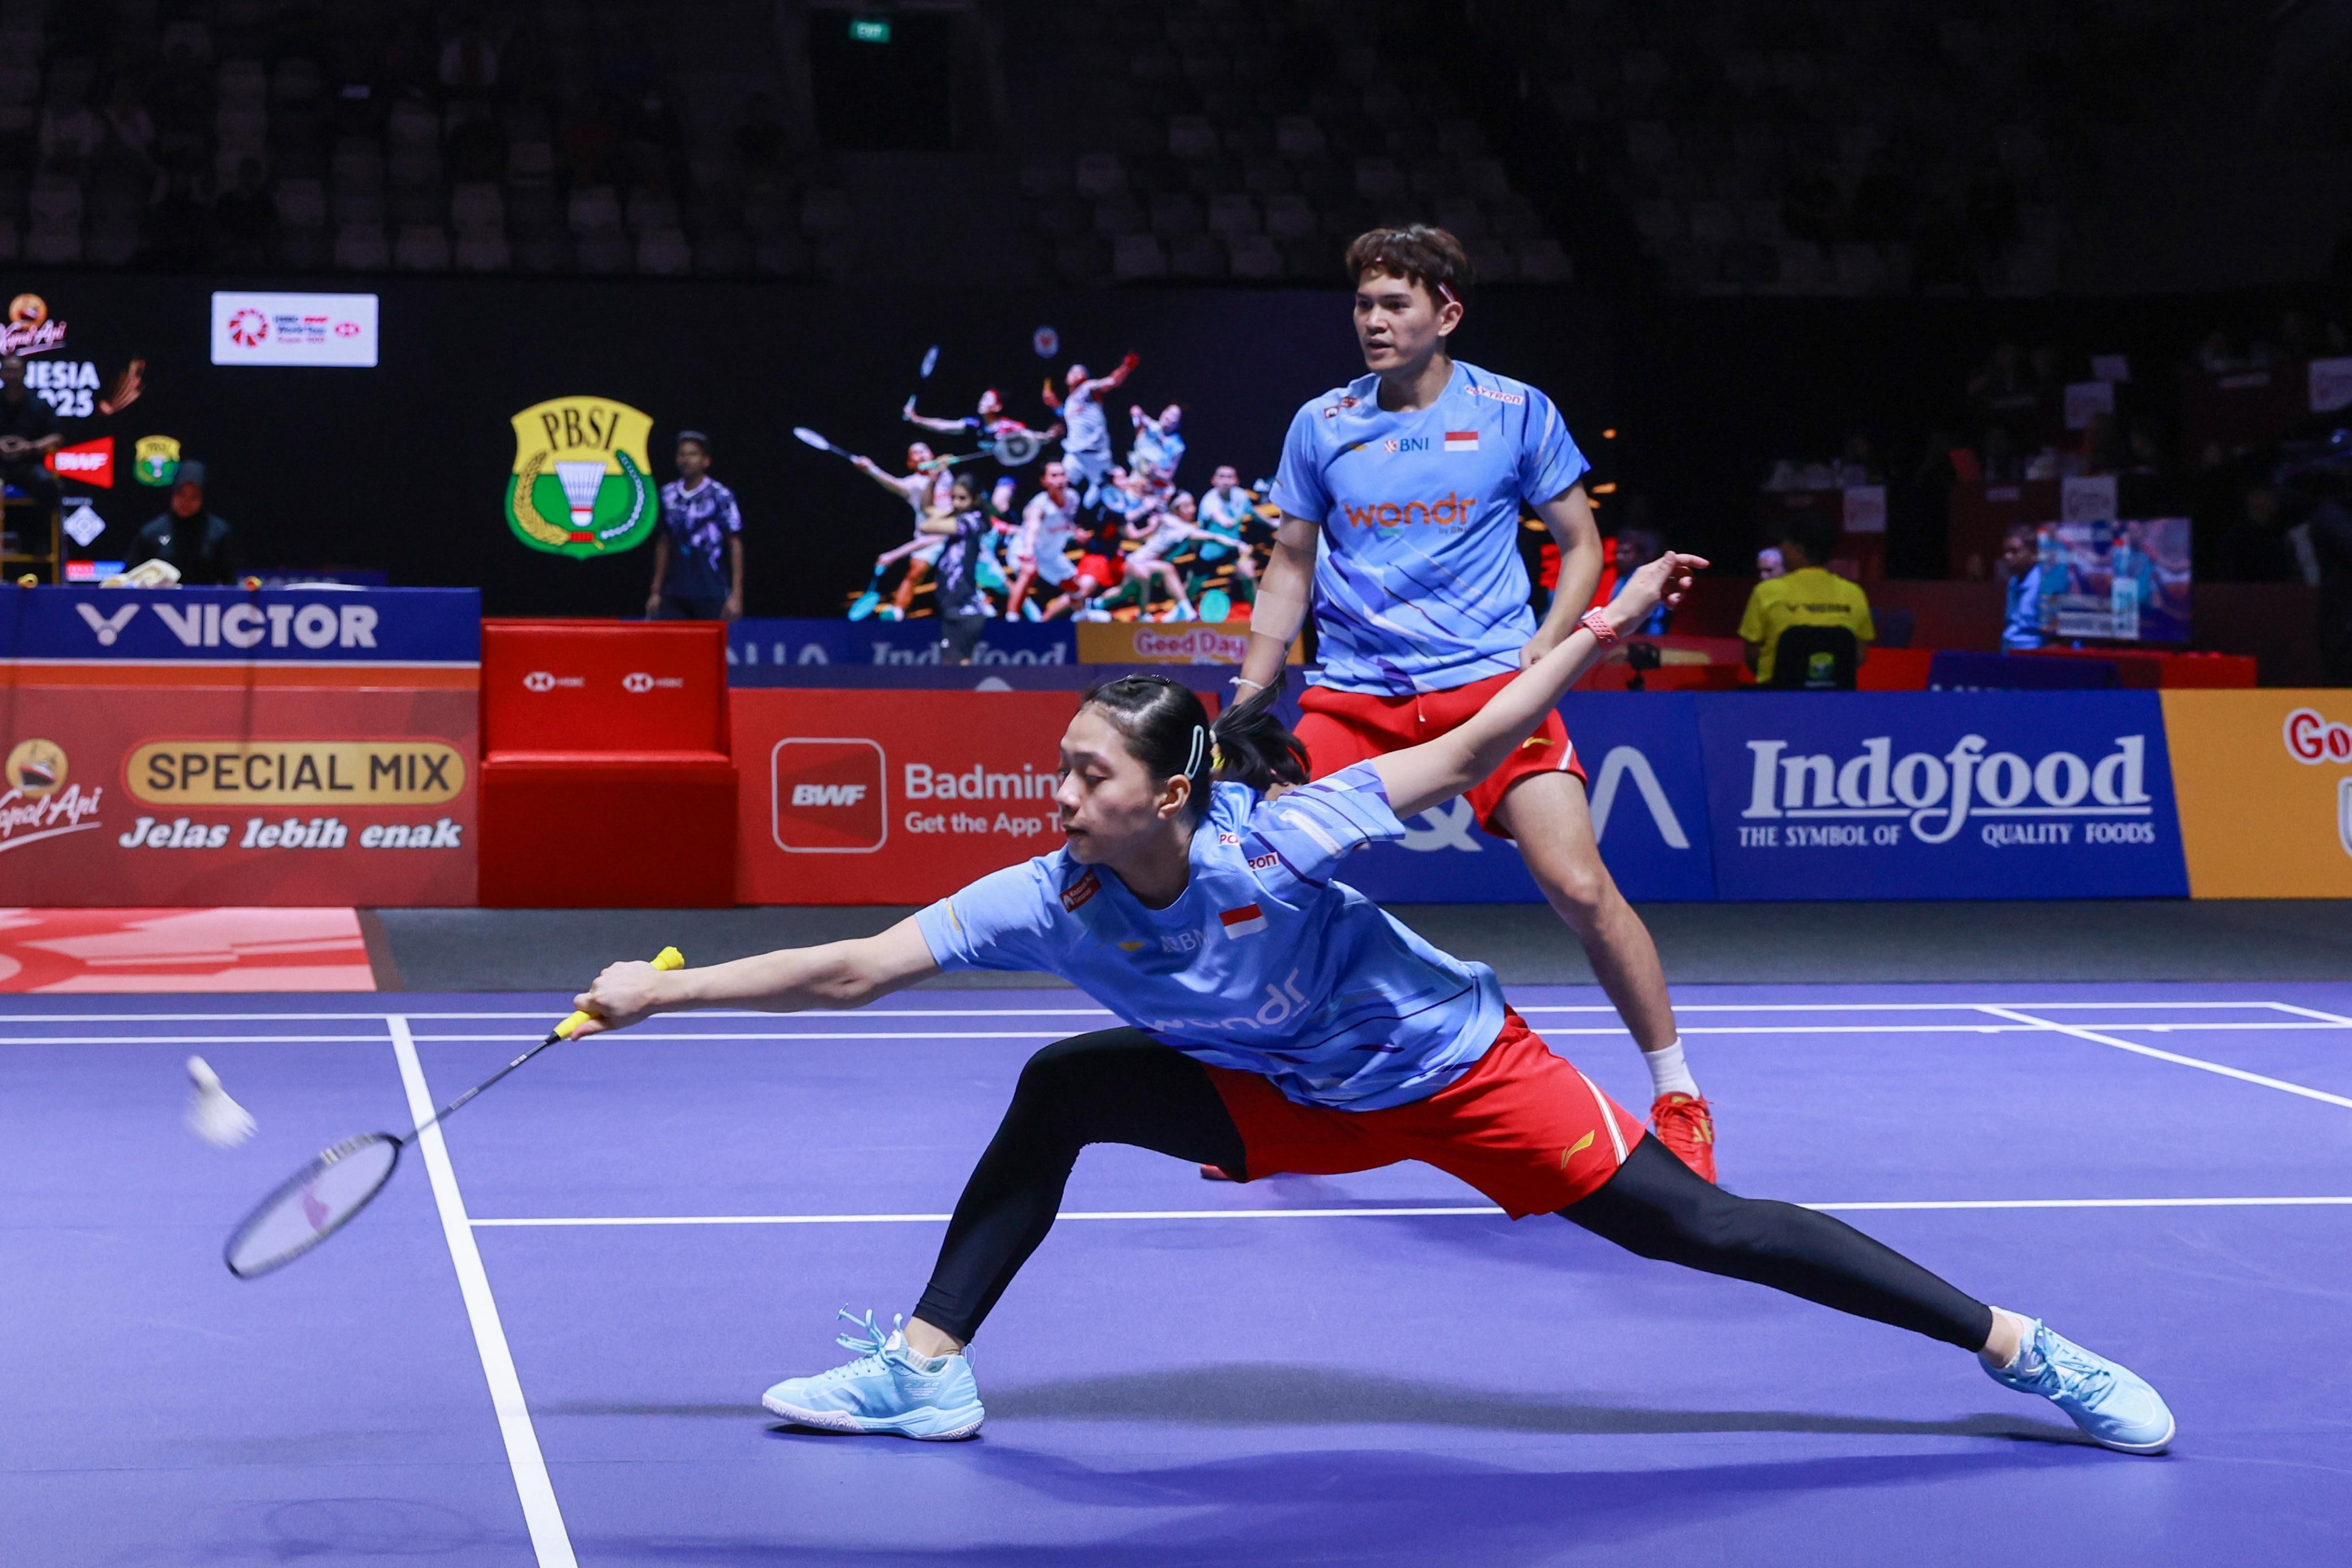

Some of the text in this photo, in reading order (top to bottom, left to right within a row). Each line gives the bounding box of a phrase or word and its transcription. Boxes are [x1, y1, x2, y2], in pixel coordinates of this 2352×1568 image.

[541, 406, 620, 451] PBSI
[1400, 438, 1429, 452] BNI
[1344, 491, 1476, 529] wondr
[152, 603, 379, 648] VICTOR
[147, 752, 451, 792] SPECIAL MIX
[905, 763, 1062, 799] Badmin
[1741, 734, 2151, 843] Indofood
[792, 784, 867, 807] BWF
[118, 816, 463, 849] Jelas lebih enak
[905, 812, 945, 834] Get
[951, 812, 987, 833] the
[993, 812, 1043, 838] App
[1738, 826, 1901, 846] THE SYMBOL OF
[1981, 822, 2156, 847] QUALITY FOODS
